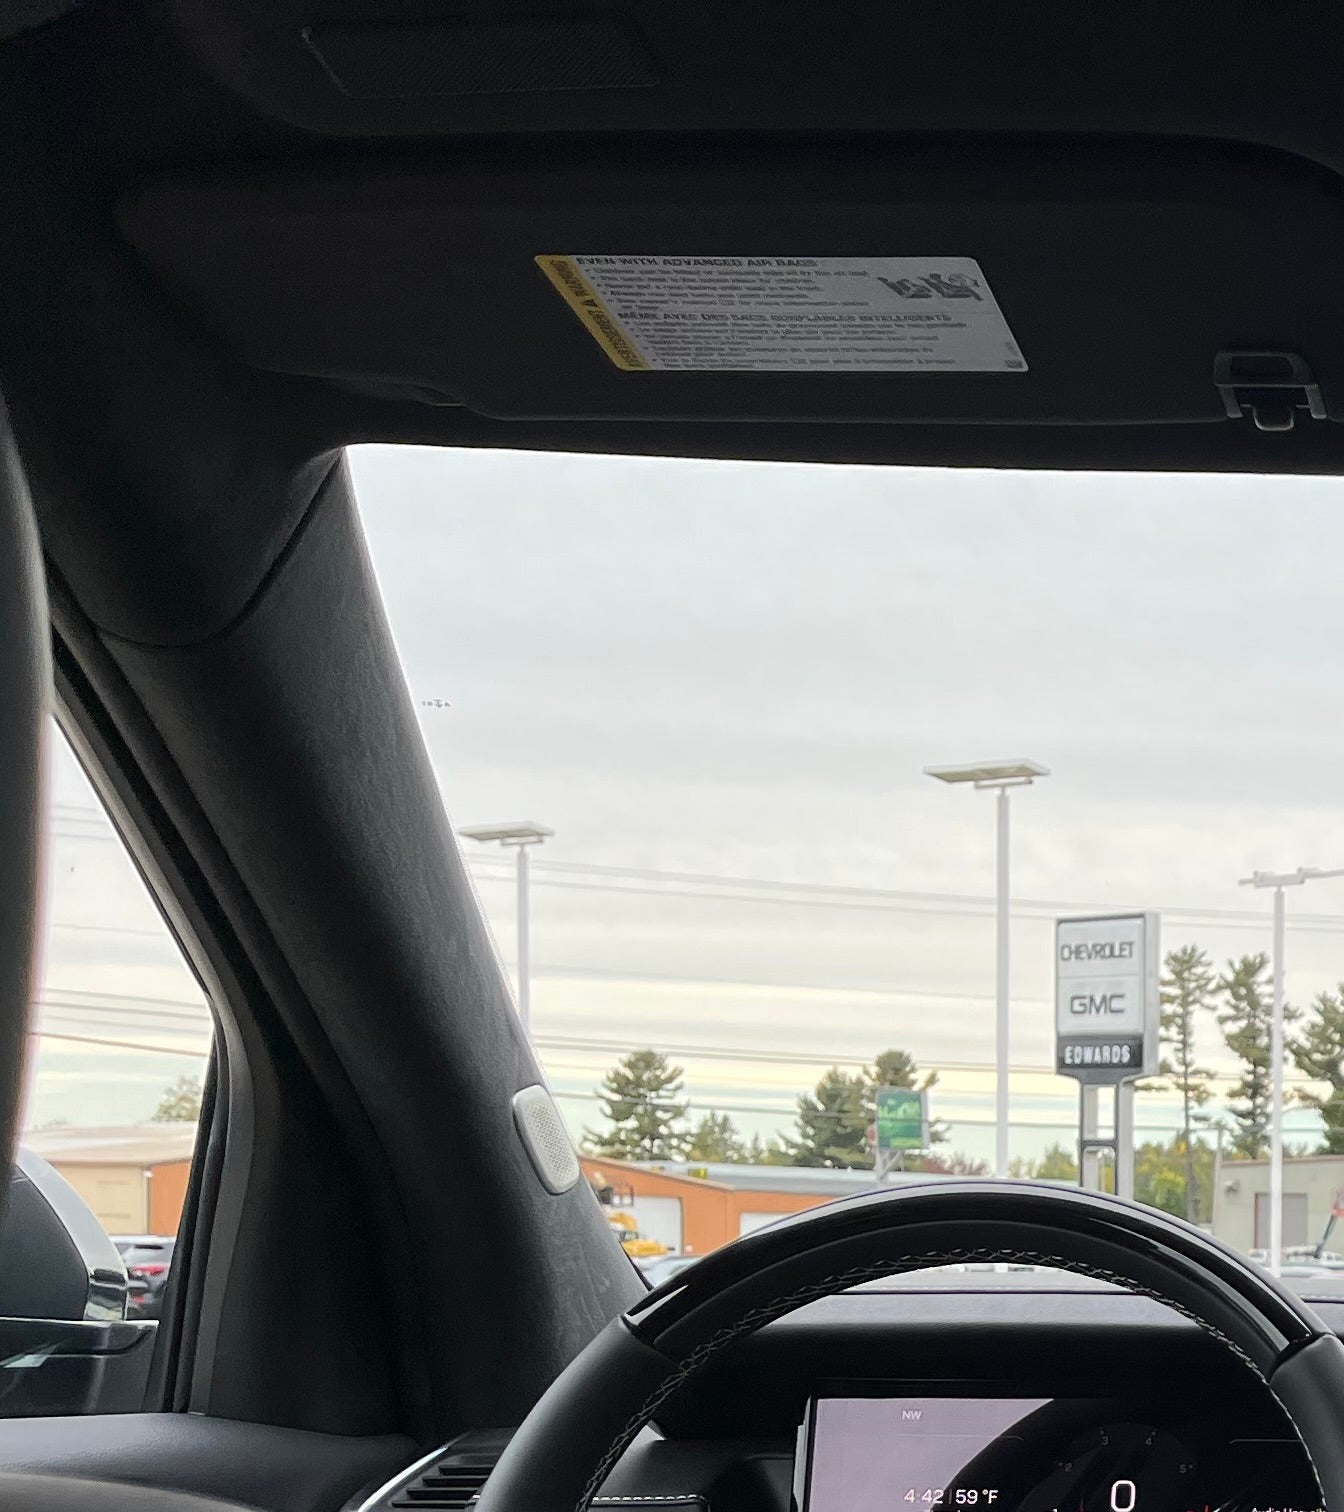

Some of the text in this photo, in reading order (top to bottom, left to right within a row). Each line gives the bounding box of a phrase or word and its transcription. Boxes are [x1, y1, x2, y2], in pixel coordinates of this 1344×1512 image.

[1060, 941, 1134, 961] CHEVROLET
[1070, 993, 1125, 1015] GMC
[1064, 1045, 1131, 1064] EDWARDS
[902, 1409, 922, 1420] NW
[904, 1489, 944, 1504] 4:42
[955, 1489, 978, 1504] 59
[1110, 1479, 1136, 1512] 0
